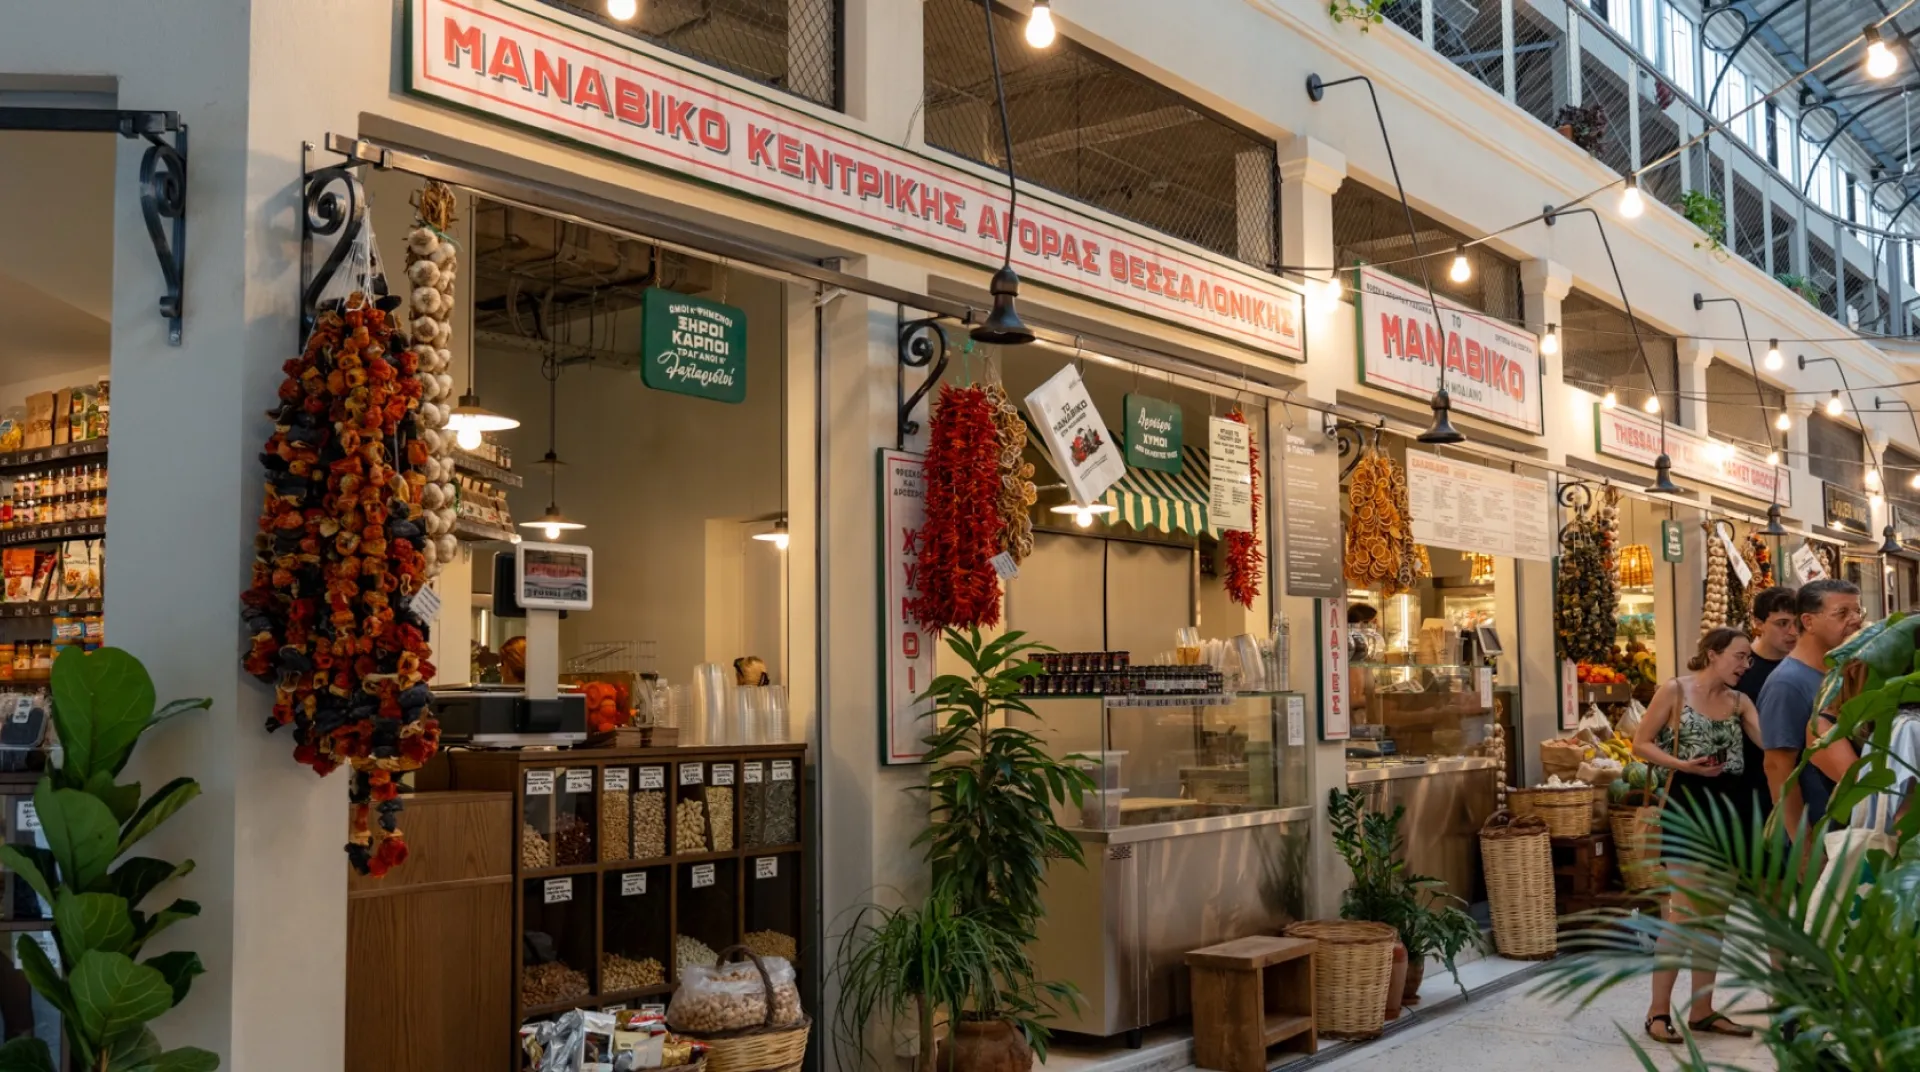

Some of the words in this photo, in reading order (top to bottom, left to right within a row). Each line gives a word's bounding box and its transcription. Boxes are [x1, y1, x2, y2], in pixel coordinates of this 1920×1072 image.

[443, 16, 730, 155] ΜΑΝΑΒΙΚΟ
[747, 122, 967, 232] ΚΕΝΤΡΙΚΗΣ
[977, 203, 1100, 276] ΑΓΟΡΑΣ
[1108, 249, 1295, 338] ΘΕΣΣΑΛΟΝΙΚΗΣ
[677, 315, 724, 339] ΞΗΡΟΙ
[1451, 313, 1462, 329] ΤΟ
[672, 330, 729, 356] ΚΑΡΠΟΙ
[1380, 311, 1526, 404] ΜΑΝΑΒΙΚΟ
[1142, 432, 1168, 448] ΧΥΜΟΙ
